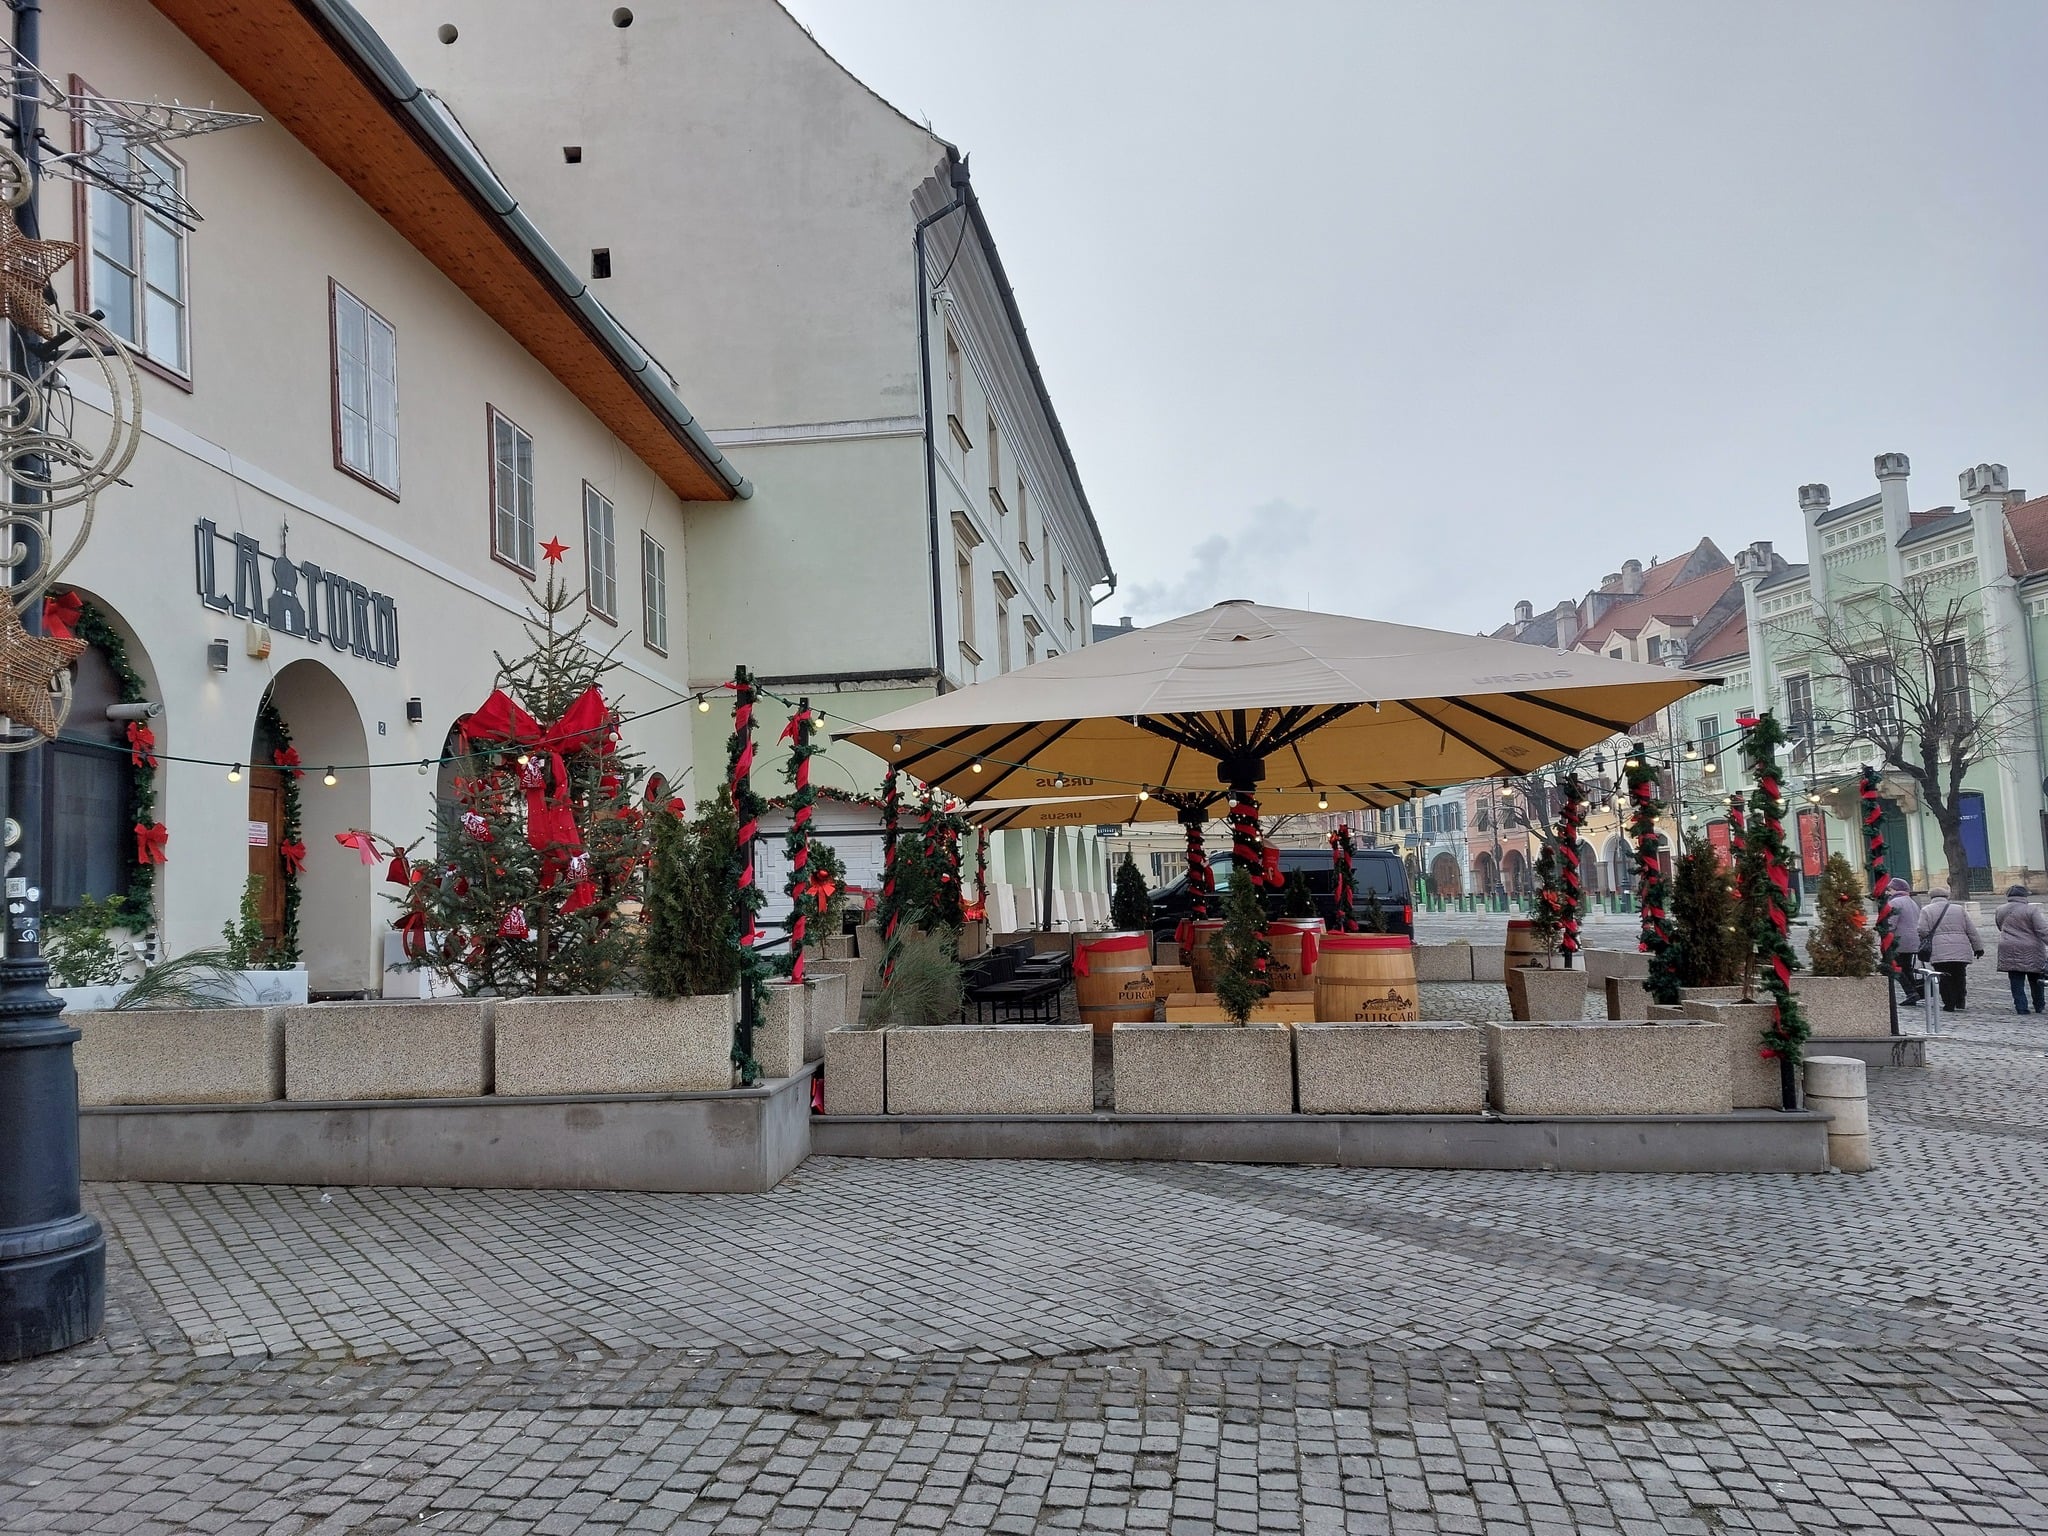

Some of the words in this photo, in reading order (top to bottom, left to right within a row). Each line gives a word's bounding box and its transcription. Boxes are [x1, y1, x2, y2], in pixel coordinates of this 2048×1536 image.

[198, 516, 267, 625] LA
[301, 560, 399, 668] TURN
[1472, 670, 1574, 684] URSUS
[1354, 1011, 1416, 1022] PURCARI
